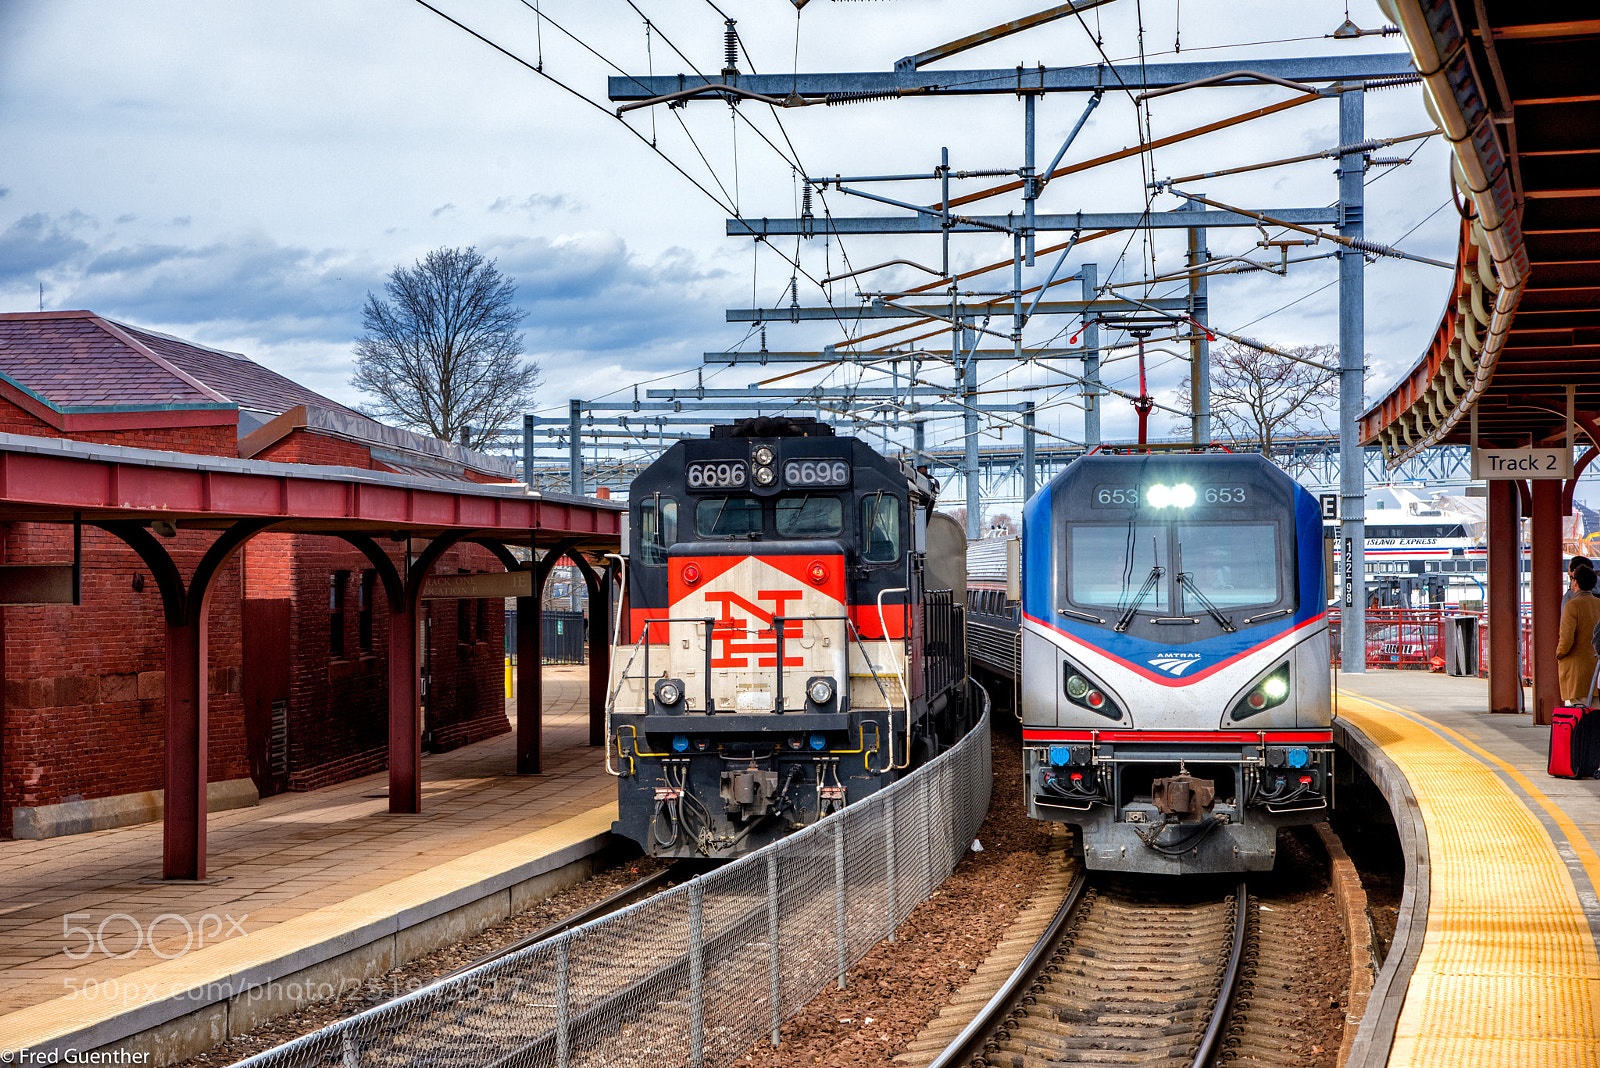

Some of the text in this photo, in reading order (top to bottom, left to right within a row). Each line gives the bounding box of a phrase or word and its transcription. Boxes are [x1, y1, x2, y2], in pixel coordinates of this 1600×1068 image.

[1487, 454, 1557, 471] Track 2
[688, 463, 746, 486] 6696
[784, 461, 847, 484] 6696
[1098, 489, 1139, 504] 653
[1204, 487, 1246, 503] 653
[1322, 496, 1335, 517] E
[1366, 538, 1438, 546] ISLAND EXPRESS
[424, 577, 477, 587] RACK ONE
[422, 586, 468, 596] OCATION
